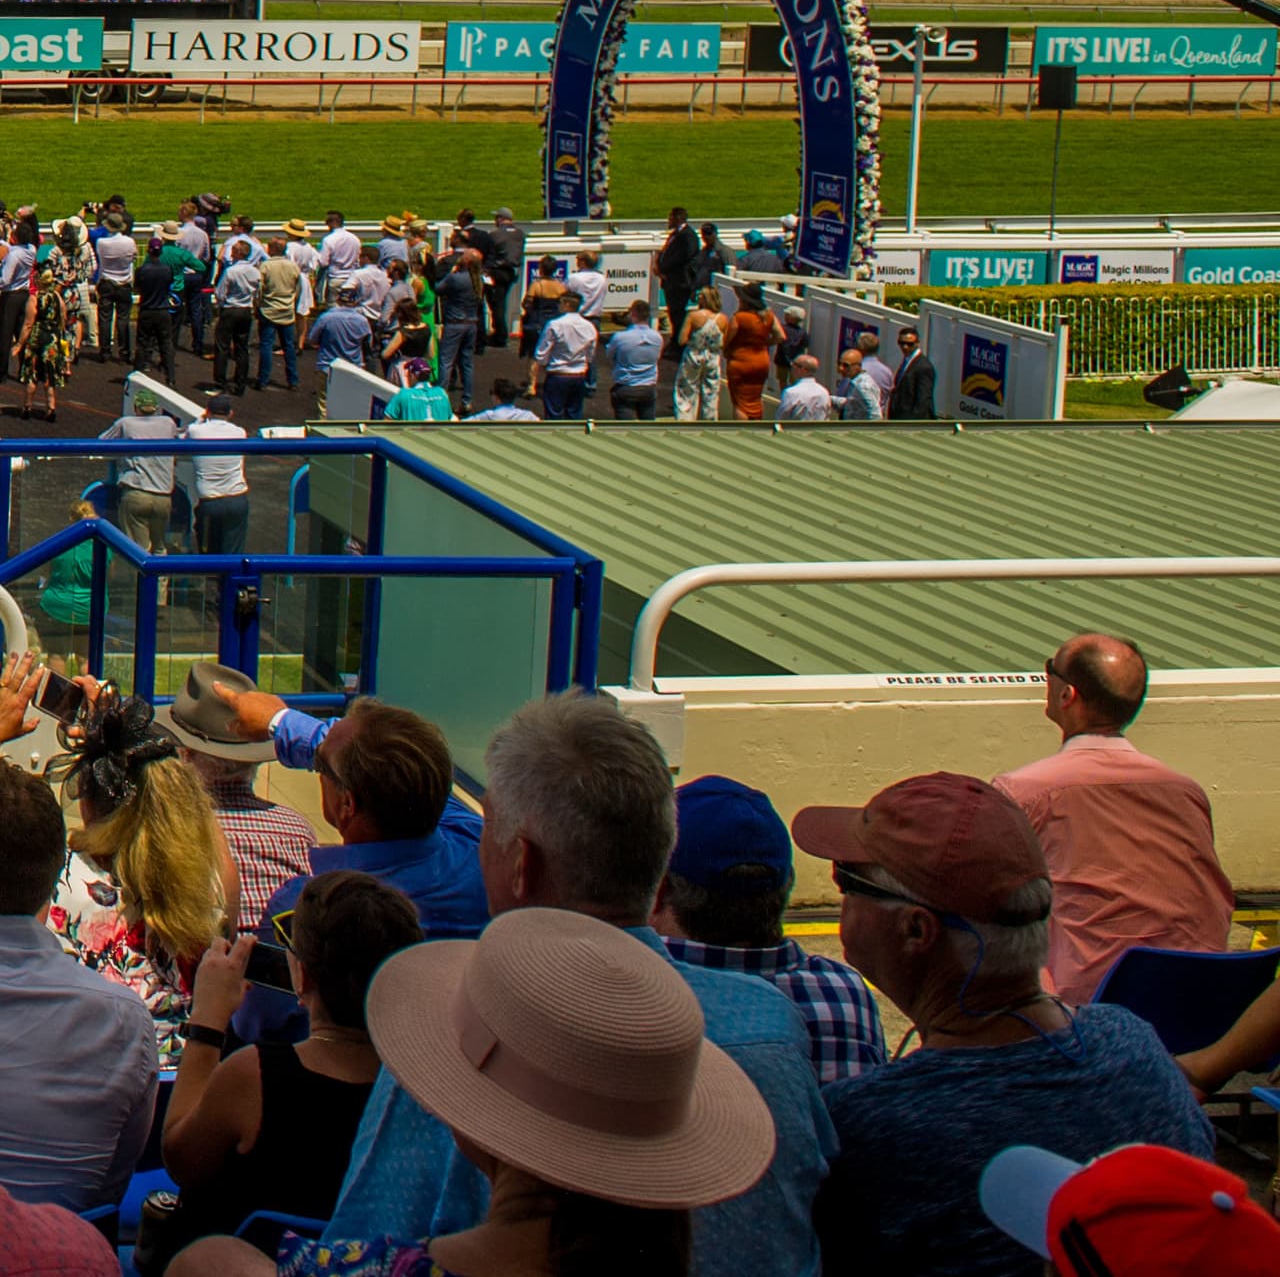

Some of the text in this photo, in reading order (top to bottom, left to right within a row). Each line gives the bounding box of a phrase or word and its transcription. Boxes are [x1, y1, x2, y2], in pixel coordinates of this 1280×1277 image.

[144, 31, 409, 62] HARROLDS
[639, 38, 711, 59] FAIR
[870, 39, 978, 61] EXUS
[1047, 34, 1268, 68] IT'S LIVE! in Queensland
[607, 268, 647, 279] Millions
[877, 266, 915, 276] Millions
[945, 257, 1034, 280] IT'S LIVE!
[1066, 262, 1095, 271] MAGIC
[1101, 265, 1169, 276] Magic Millions
[1188, 266, 1280, 284] Gold Coas
[607, 282, 638, 293] Coast
[971, 345, 1001, 364] MAGIC
[959, 401, 978, 416] Gold
[887, 676, 941, 685] PLEASE
[946, 675, 965, 684] BE
[970, 674, 1026, 684] SEATED
